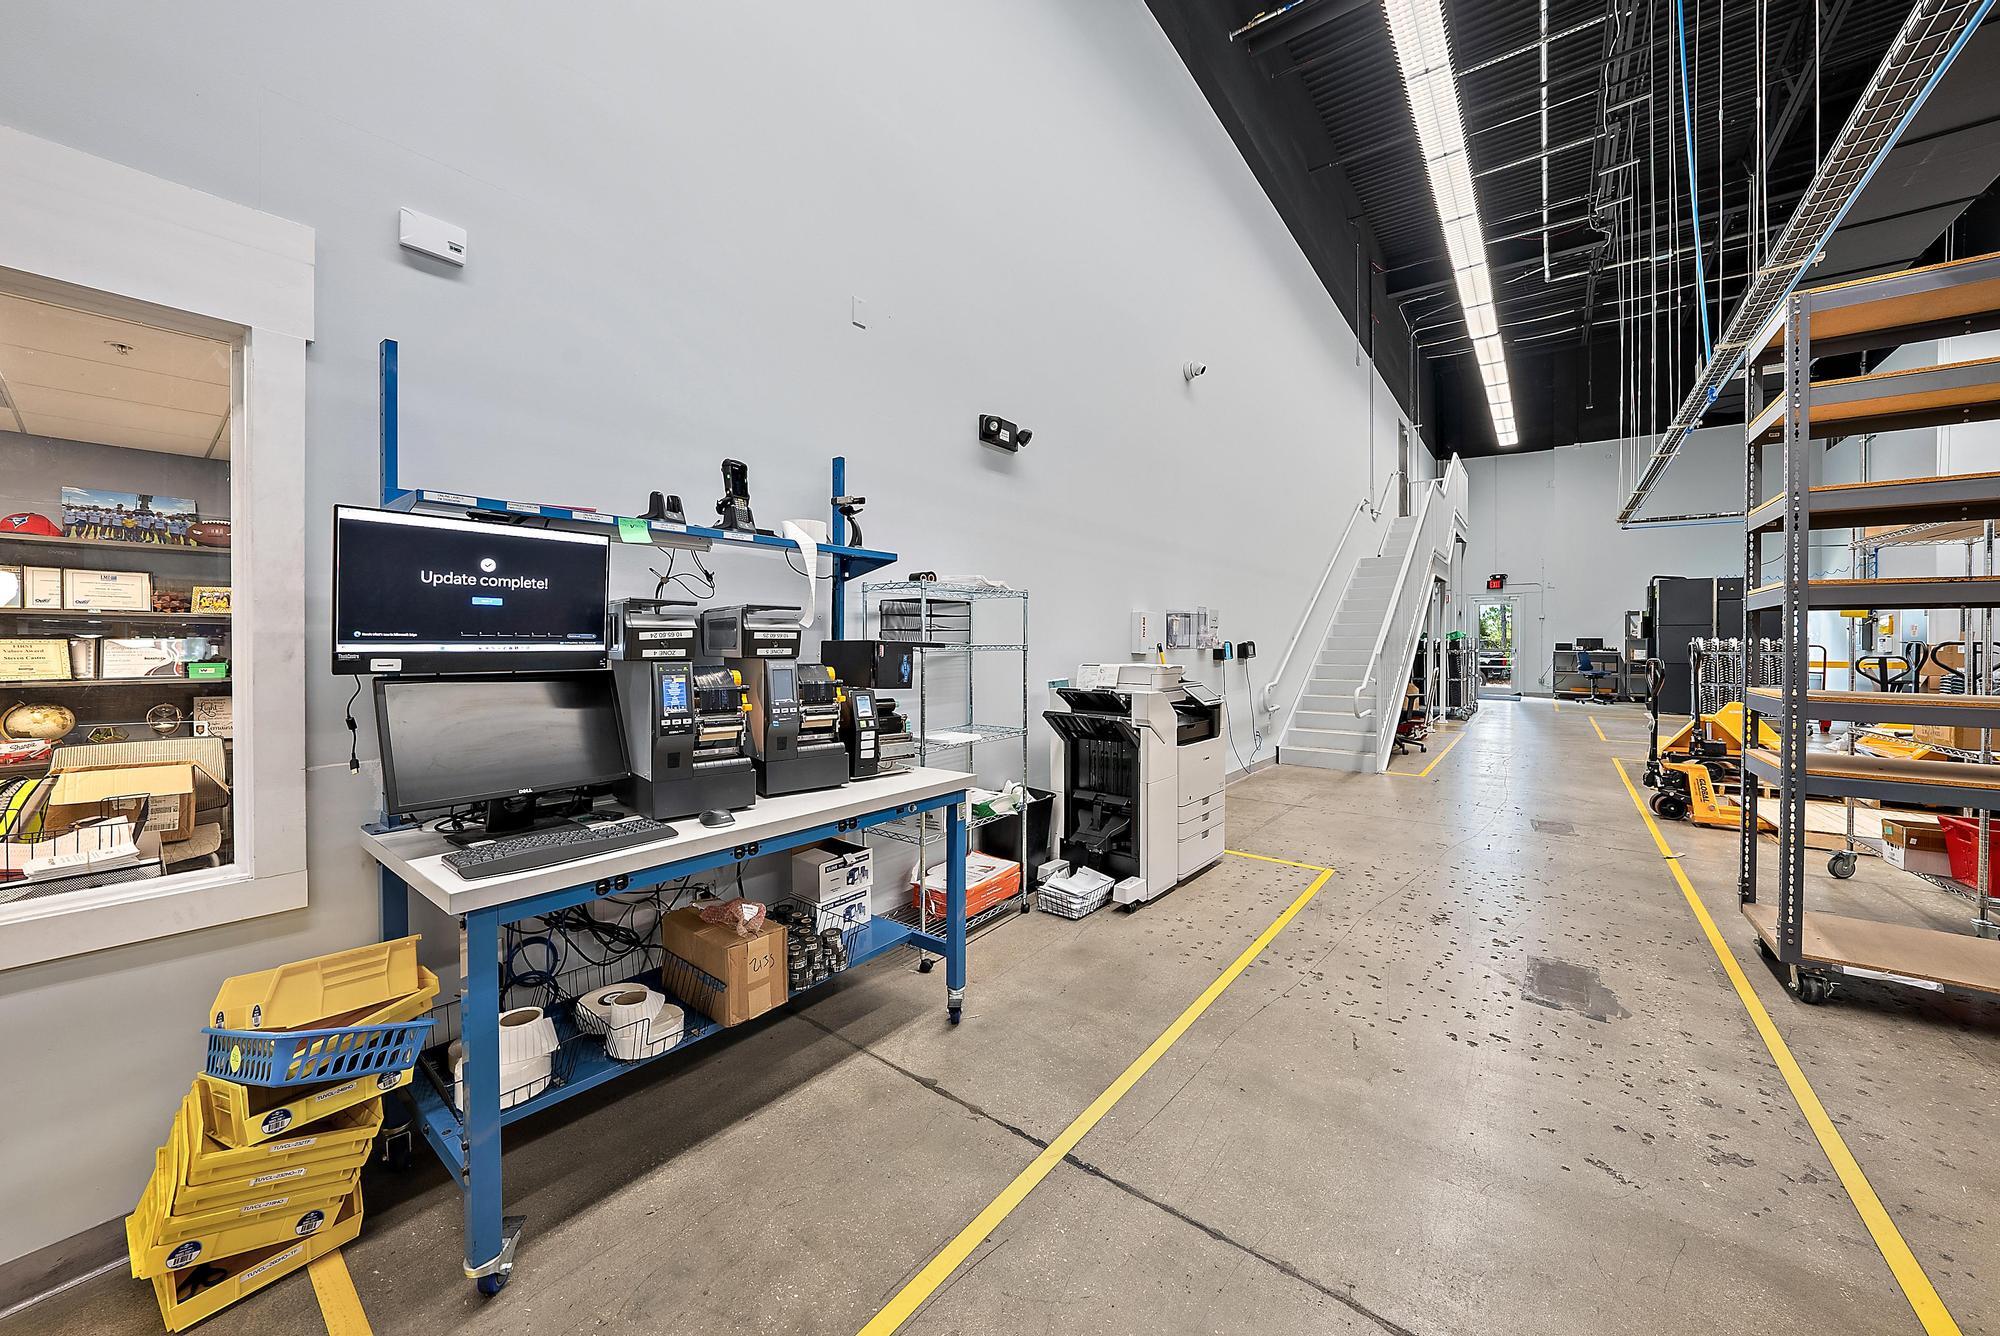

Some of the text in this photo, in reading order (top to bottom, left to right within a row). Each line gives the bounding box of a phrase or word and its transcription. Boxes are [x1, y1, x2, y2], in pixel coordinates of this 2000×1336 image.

[421, 570, 548, 590] Update complete!
[9, 742, 37, 752] Sharpie
[1700, 778, 1709, 803] GLOBAL
